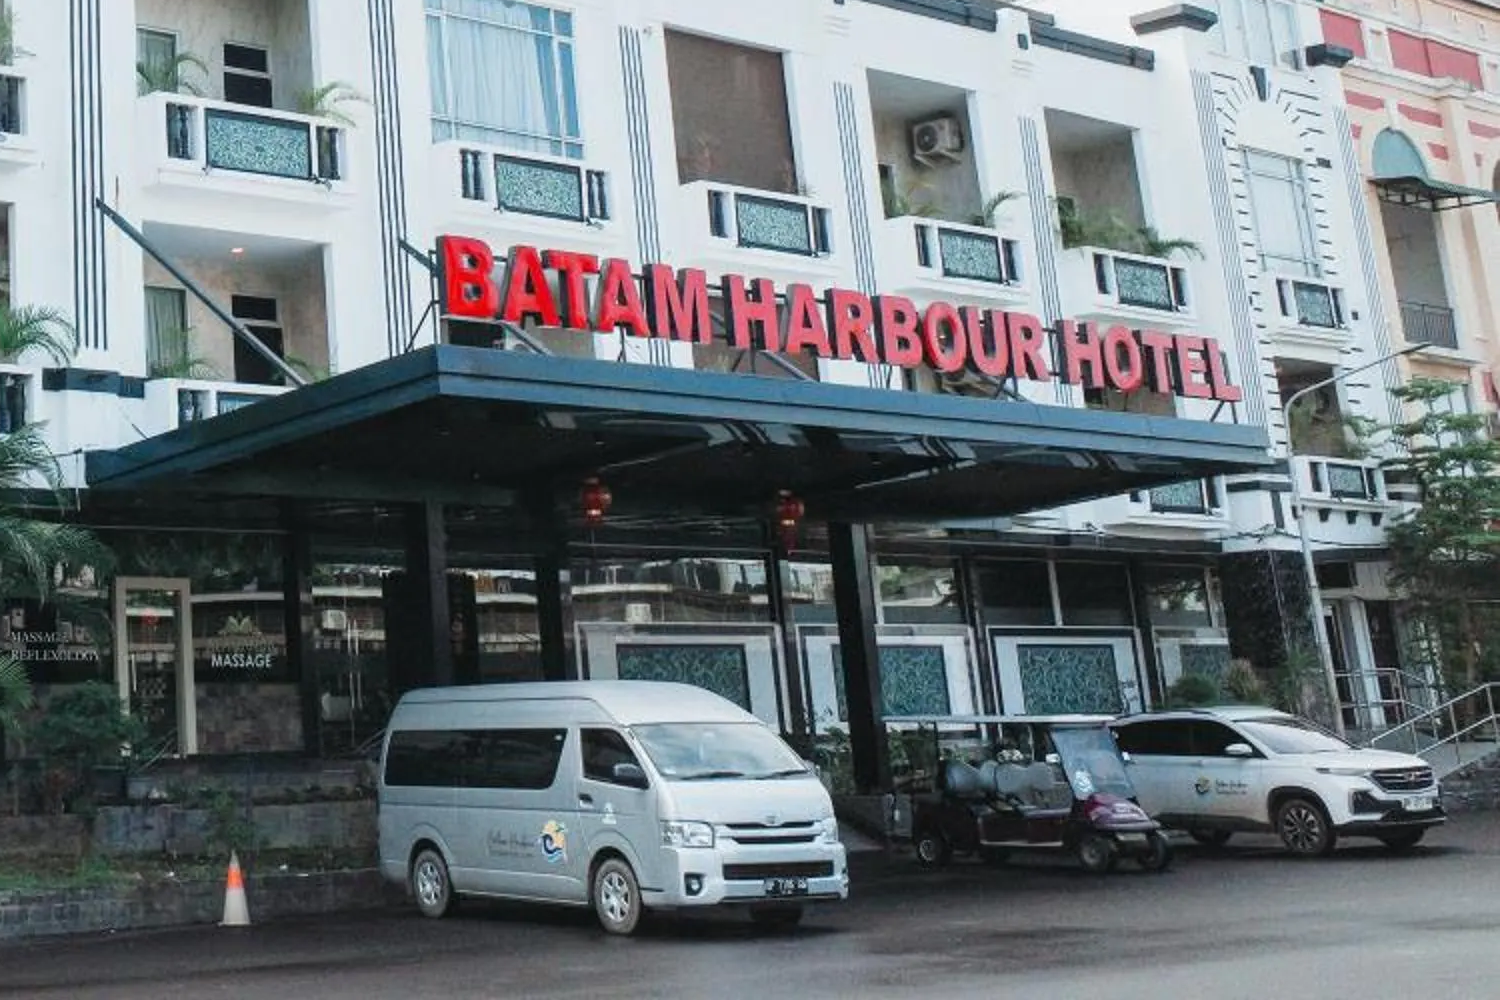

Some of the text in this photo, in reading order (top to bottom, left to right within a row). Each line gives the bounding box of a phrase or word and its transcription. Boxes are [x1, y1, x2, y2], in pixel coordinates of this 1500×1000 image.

[436, 234, 1241, 401] BATAM HARBOUR HOTEL
[11, 631, 69, 643] MASSAGE
[211, 653, 272, 668] MASSAGE
